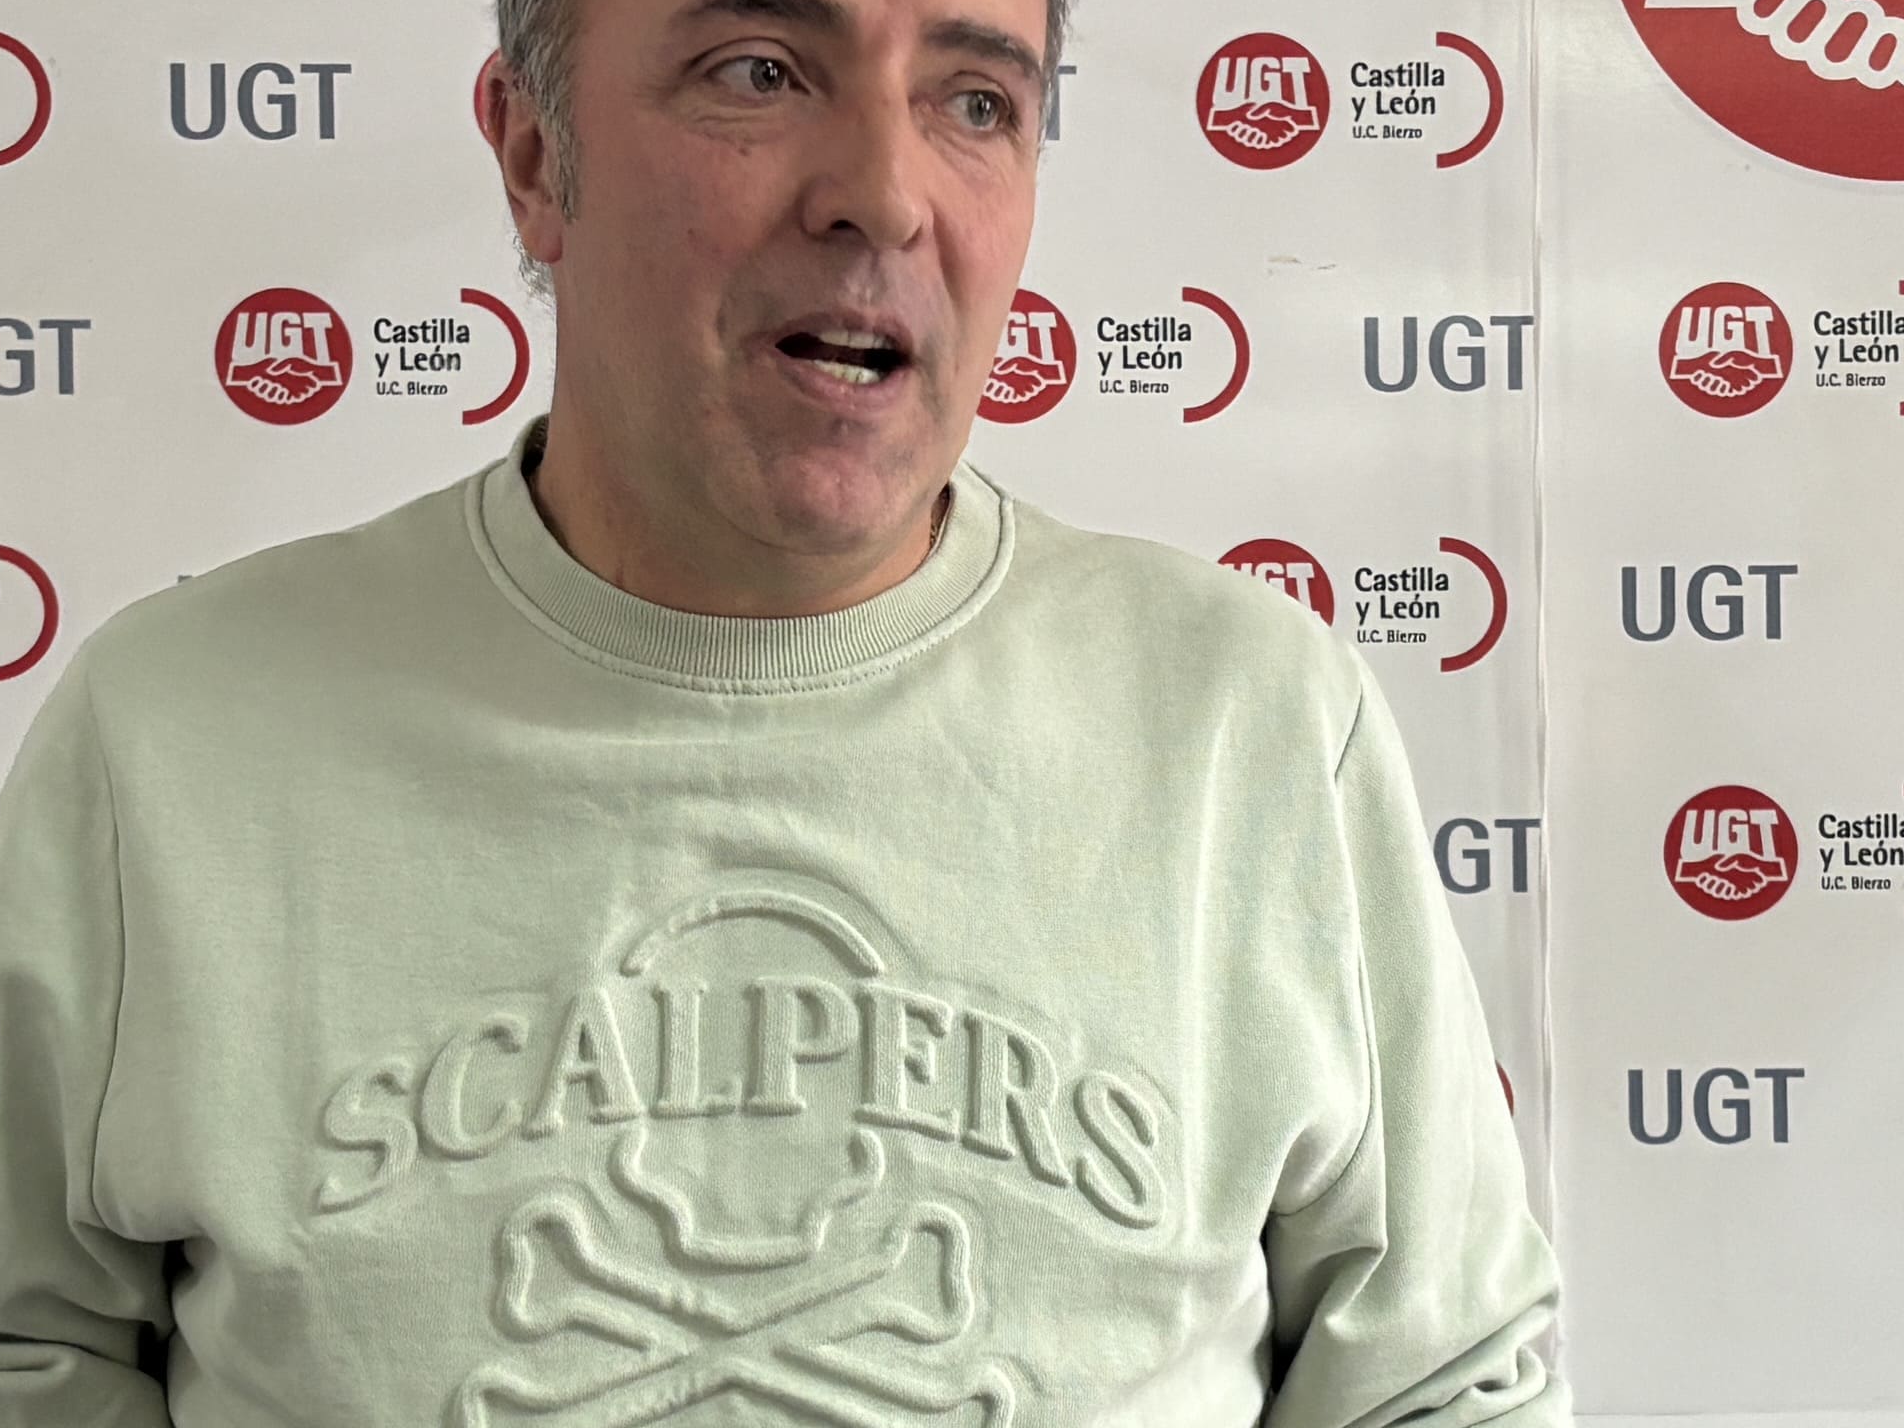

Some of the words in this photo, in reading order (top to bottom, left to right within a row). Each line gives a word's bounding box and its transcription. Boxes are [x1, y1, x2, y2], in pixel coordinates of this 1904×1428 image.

[1213, 57, 1311, 106] UGT
[1351, 62, 1444, 88] Castilla
[170, 63, 351, 140] UGT
[1351, 97, 1366, 122] y
[1376, 88, 1435, 115] León
[1353, 125, 1378, 138] U.C.
[1383, 125, 1422, 139] Bierzo
[233, 312, 334, 362] UGT
[374, 318, 469, 343] Castilla
[996, 311, 1057, 364] GT
[1097, 317, 1191, 342] Castilla
[1677, 306, 1774, 355] UGT
[375, 353, 389, 378] y
[400, 345, 460, 371] León
[1098, 352, 1112, 376] y
[1123, 343, 1182, 369] León
[1365, 316, 1534, 392] UGT
[1815, 345, 1829, 370] y
[1839, 336, 1899, 362] León
[377, 381, 402, 395] U.C.
[407, 381, 447, 395] Bierzo
[1100, 380, 1124, 393] U.C.
[1130, 380, 1169, 393] Bierzo
[1816, 373, 1841, 387] U.C.
[1846, 373, 1885, 386] Bierzo
[1355, 567, 1449, 592] Castilla
[1355, 602, 1370, 626] y
[1380, 593, 1440, 619] León
[1622, 565, 1798, 641] UGT
[1357, 630, 1383, 643] U.C.
[1387, 630, 1426, 643] Bierzo
[1682, 810, 1779, 859] UGT
[1433, 818, 1541, 894] GT
[1820, 848, 1834, 873] y
[1844, 840, 1904, 866] León
[1821, 876, 1847, 890] U.C.
[1851, 876, 1891, 890] Bierzo
[315, 976, 1166, 1228] SCALPERS
[1628, 1068, 1805, 1144] UGT
